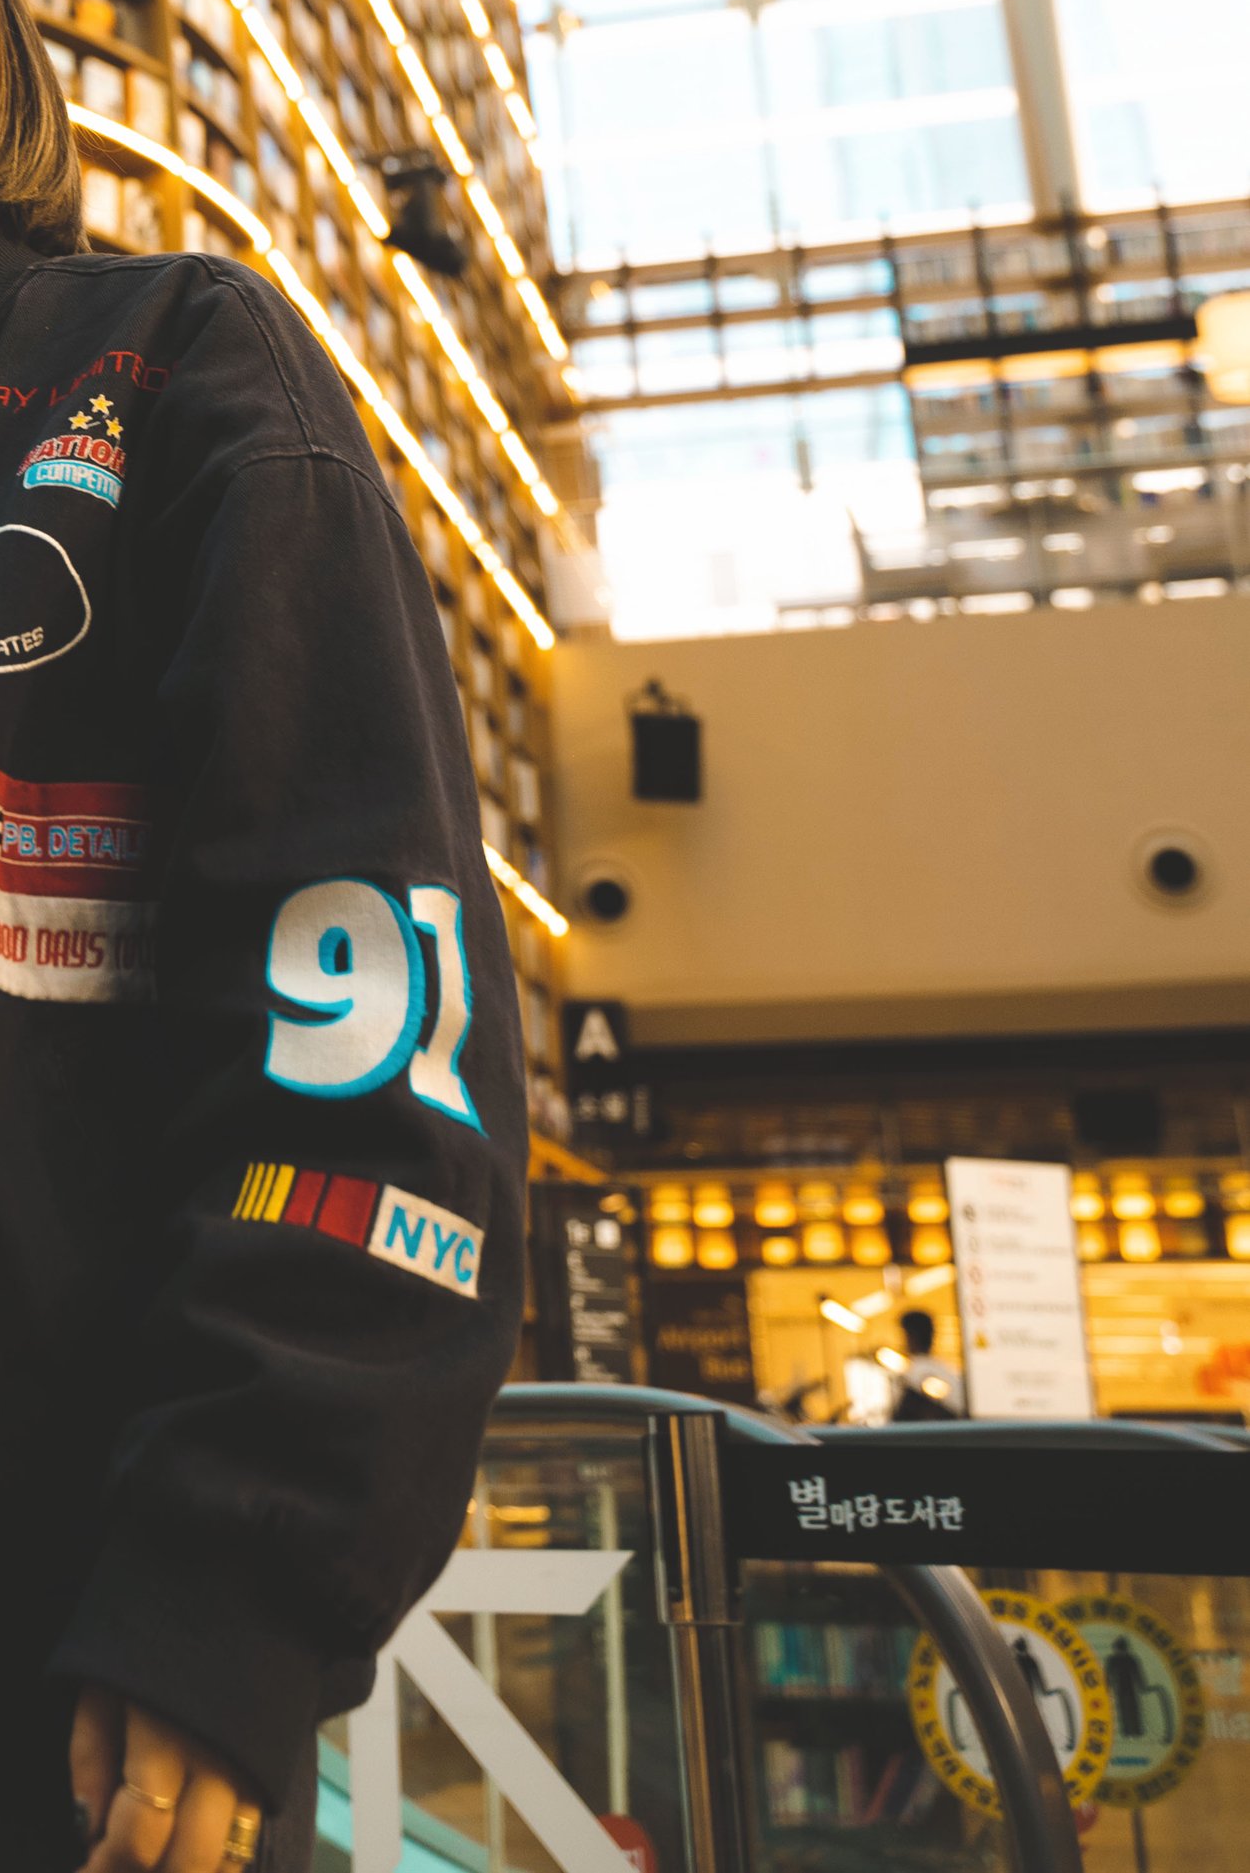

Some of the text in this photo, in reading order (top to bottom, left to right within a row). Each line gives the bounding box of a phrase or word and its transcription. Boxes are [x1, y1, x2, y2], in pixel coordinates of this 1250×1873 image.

[17, 434, 127, 478] ATION
[48, 824, 149, 861] DETAIL
[35, 927, 107, 969] DAYS
[264, 875, 489, 1140] 91
[575, 1007, 620, 1061] A
[384, 1204, 476, 1283] NYC
[787, 1475, 966, 1534] 별마당도서관
